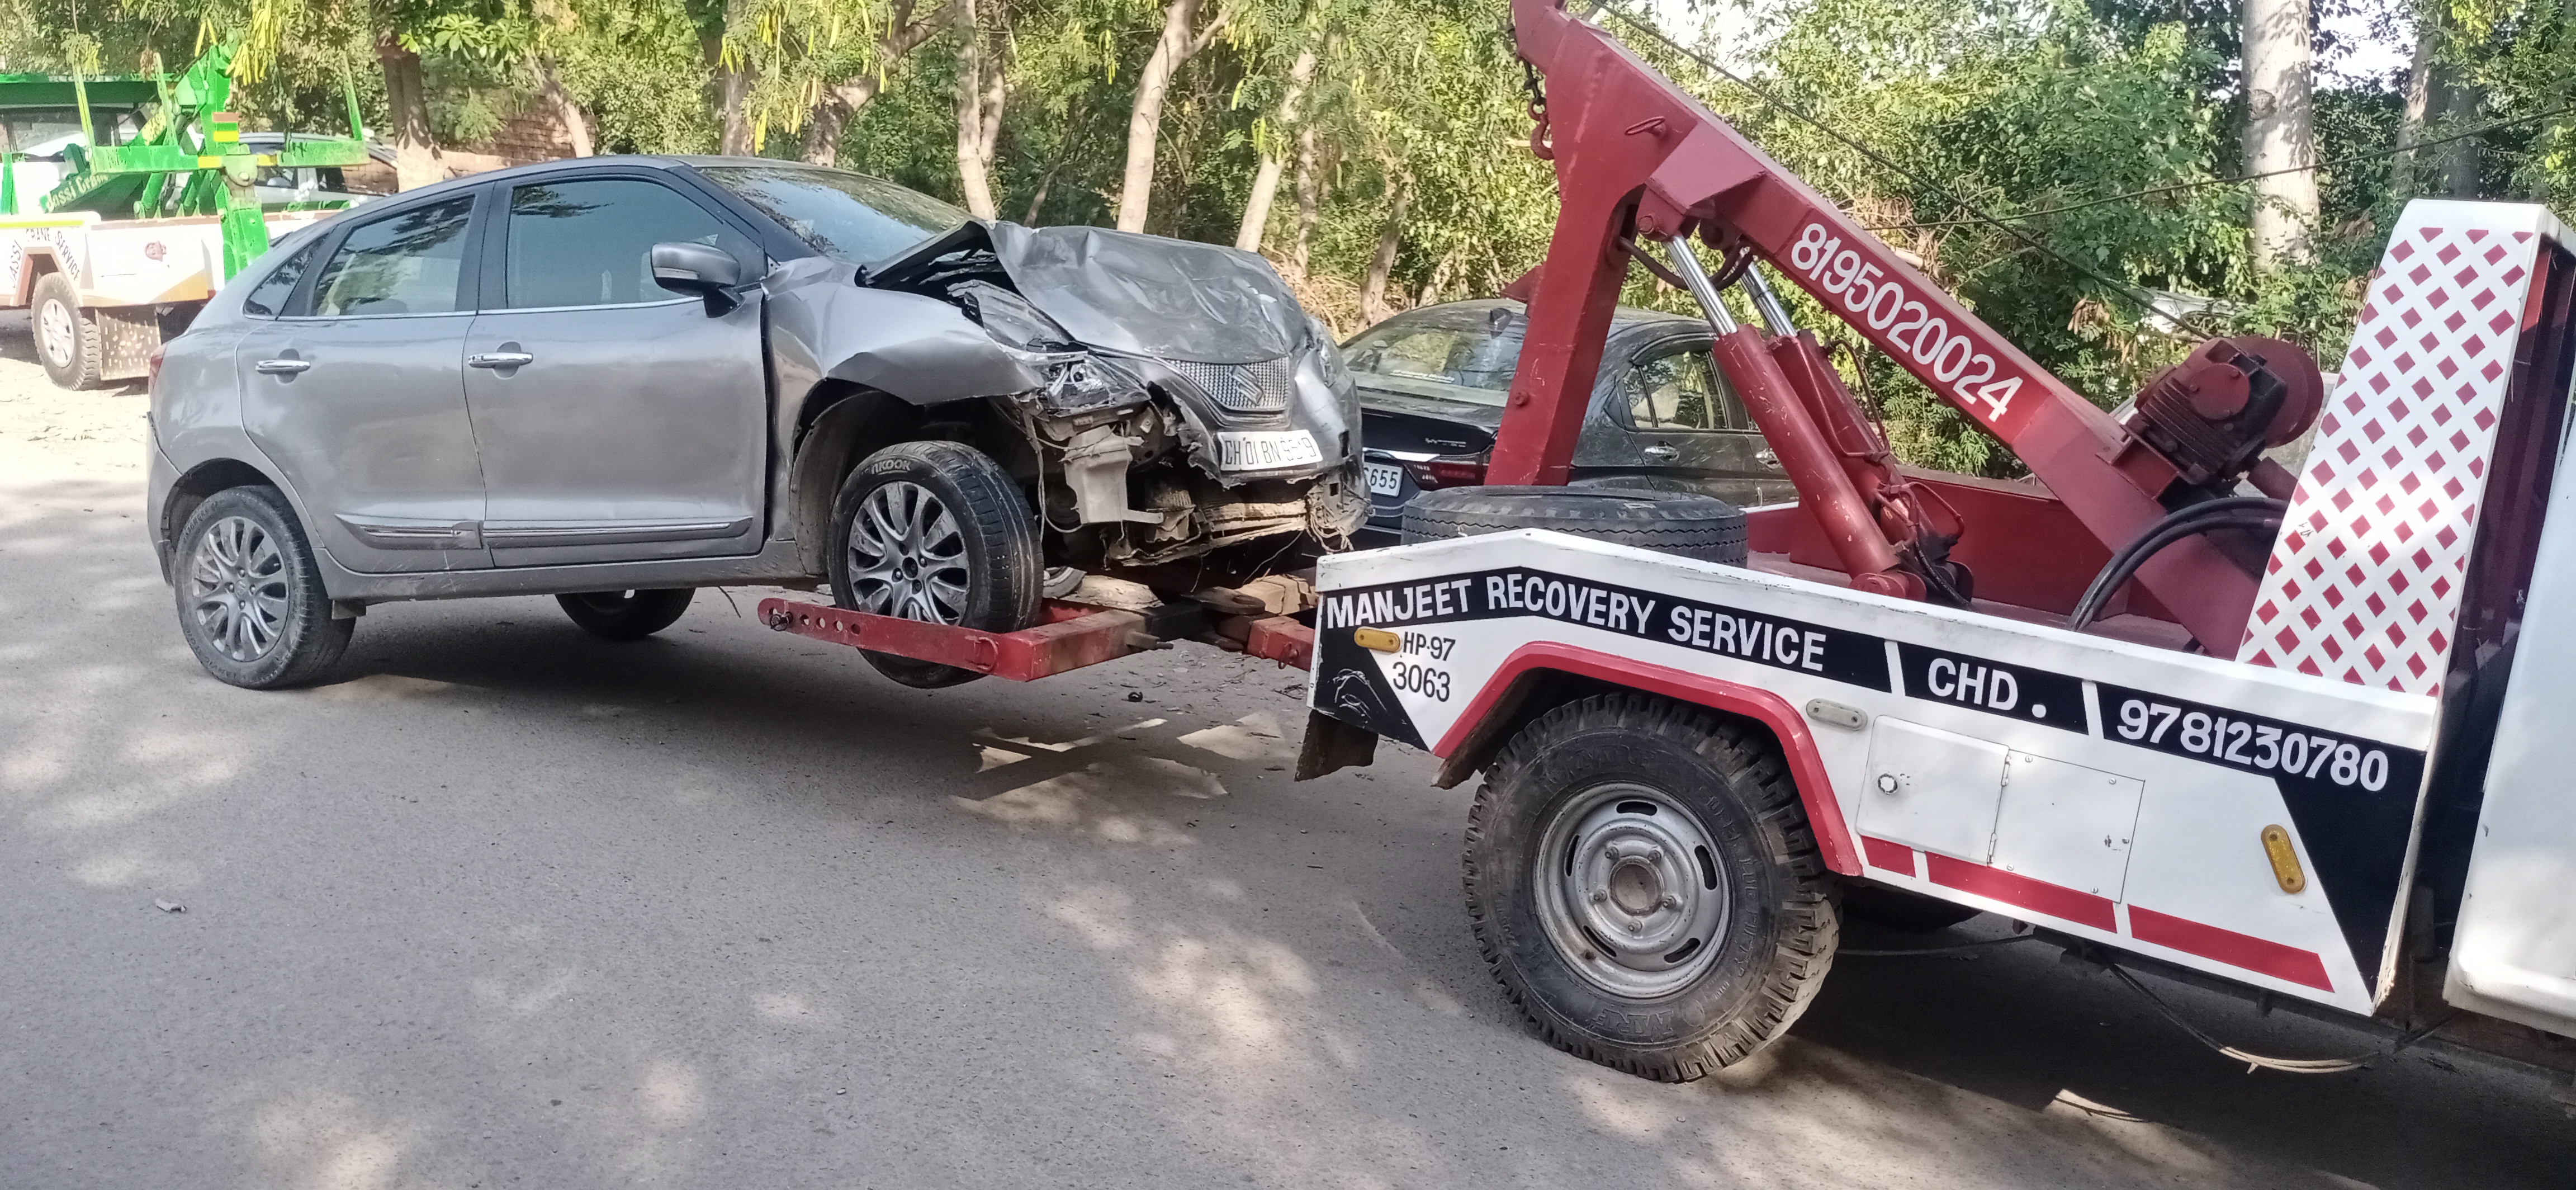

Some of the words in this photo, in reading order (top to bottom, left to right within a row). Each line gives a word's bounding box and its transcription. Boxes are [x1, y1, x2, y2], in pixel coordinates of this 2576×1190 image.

[55, 230, 80, 281] SERVICE
[1791, 223, 2023, 423] 8195020024
[1225, 440, 1242, 465] CH
[1261, 440, 1282, 464] BN
[1327, 579, 1472, 629] MANJEET
[1486, 573, 1656, 634] RECOVERY
[1667, 605, 1827, 672] SERVICE
[1392, 661, 1451, 703] 3063
[2116, 699, 2389, 792] 9781230780
